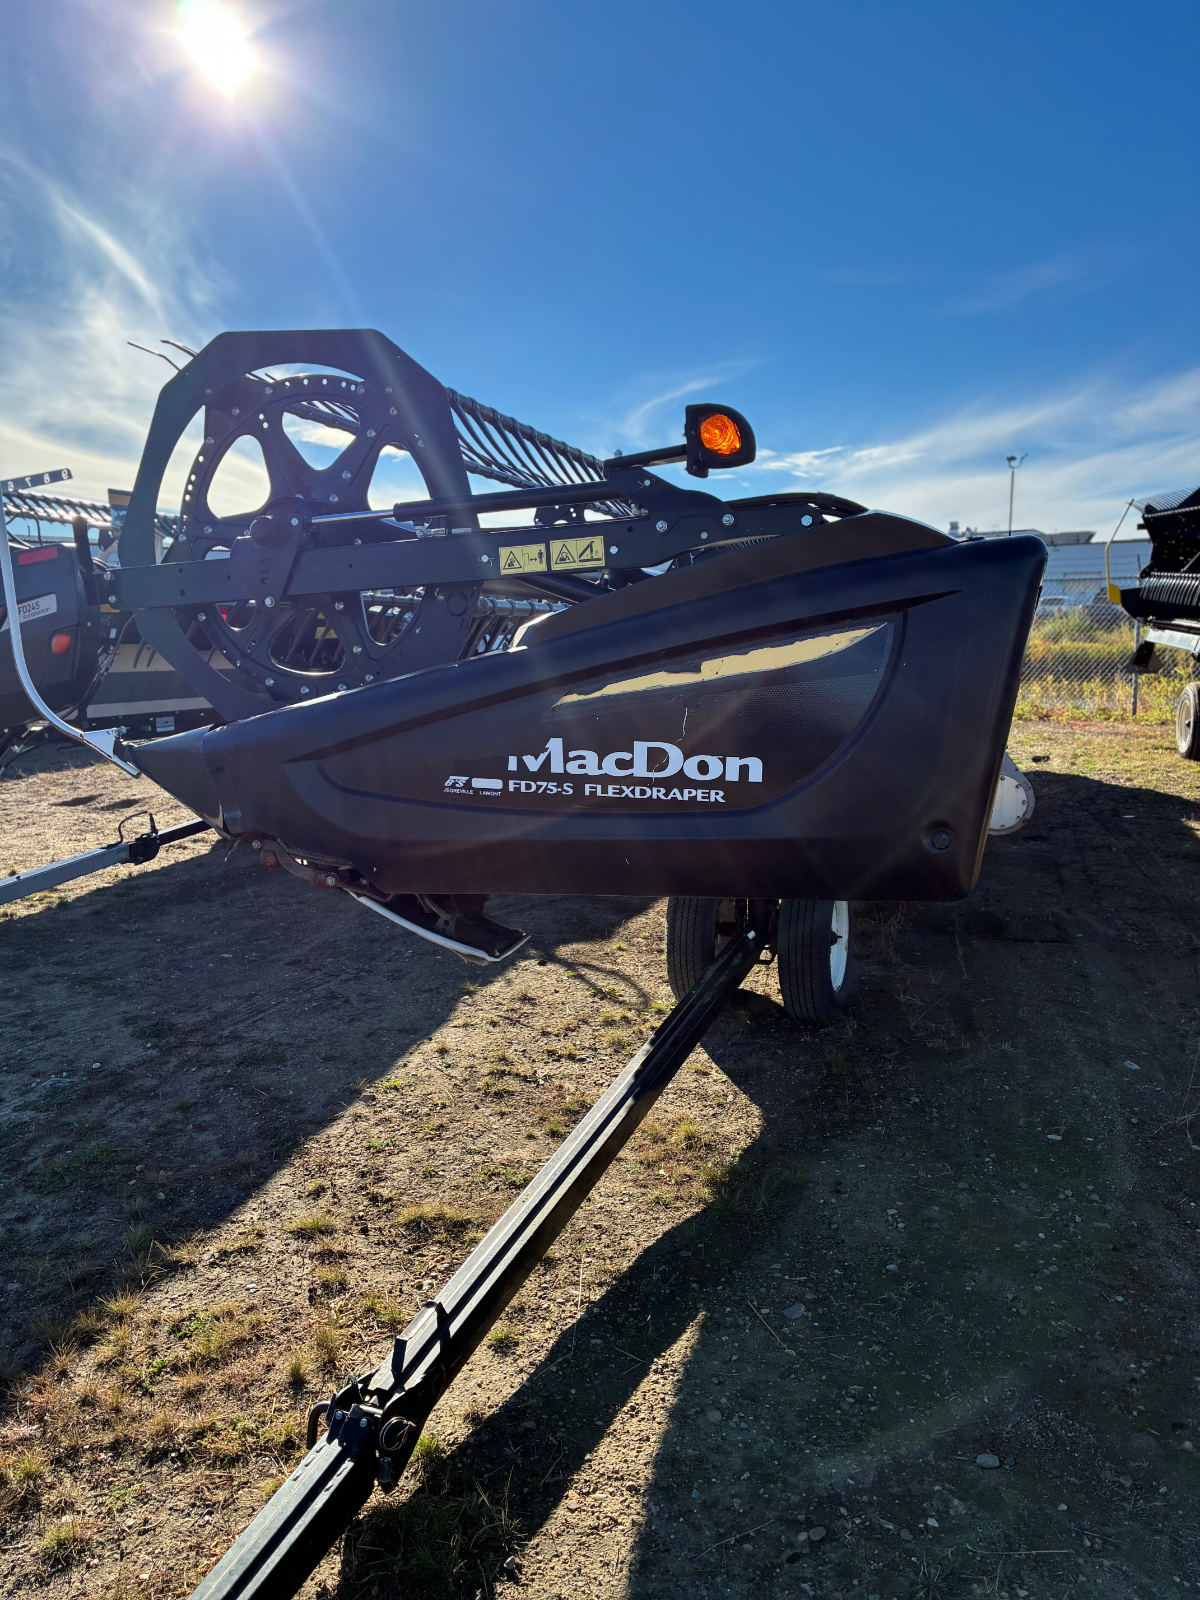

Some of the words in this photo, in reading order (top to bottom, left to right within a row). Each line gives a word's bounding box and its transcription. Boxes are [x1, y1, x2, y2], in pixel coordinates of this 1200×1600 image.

[18, 600, 40, 616] FD245
[508, 779, 574, 796] FD75-S
[584, 783, 726, 803] FLEXDRAPER
